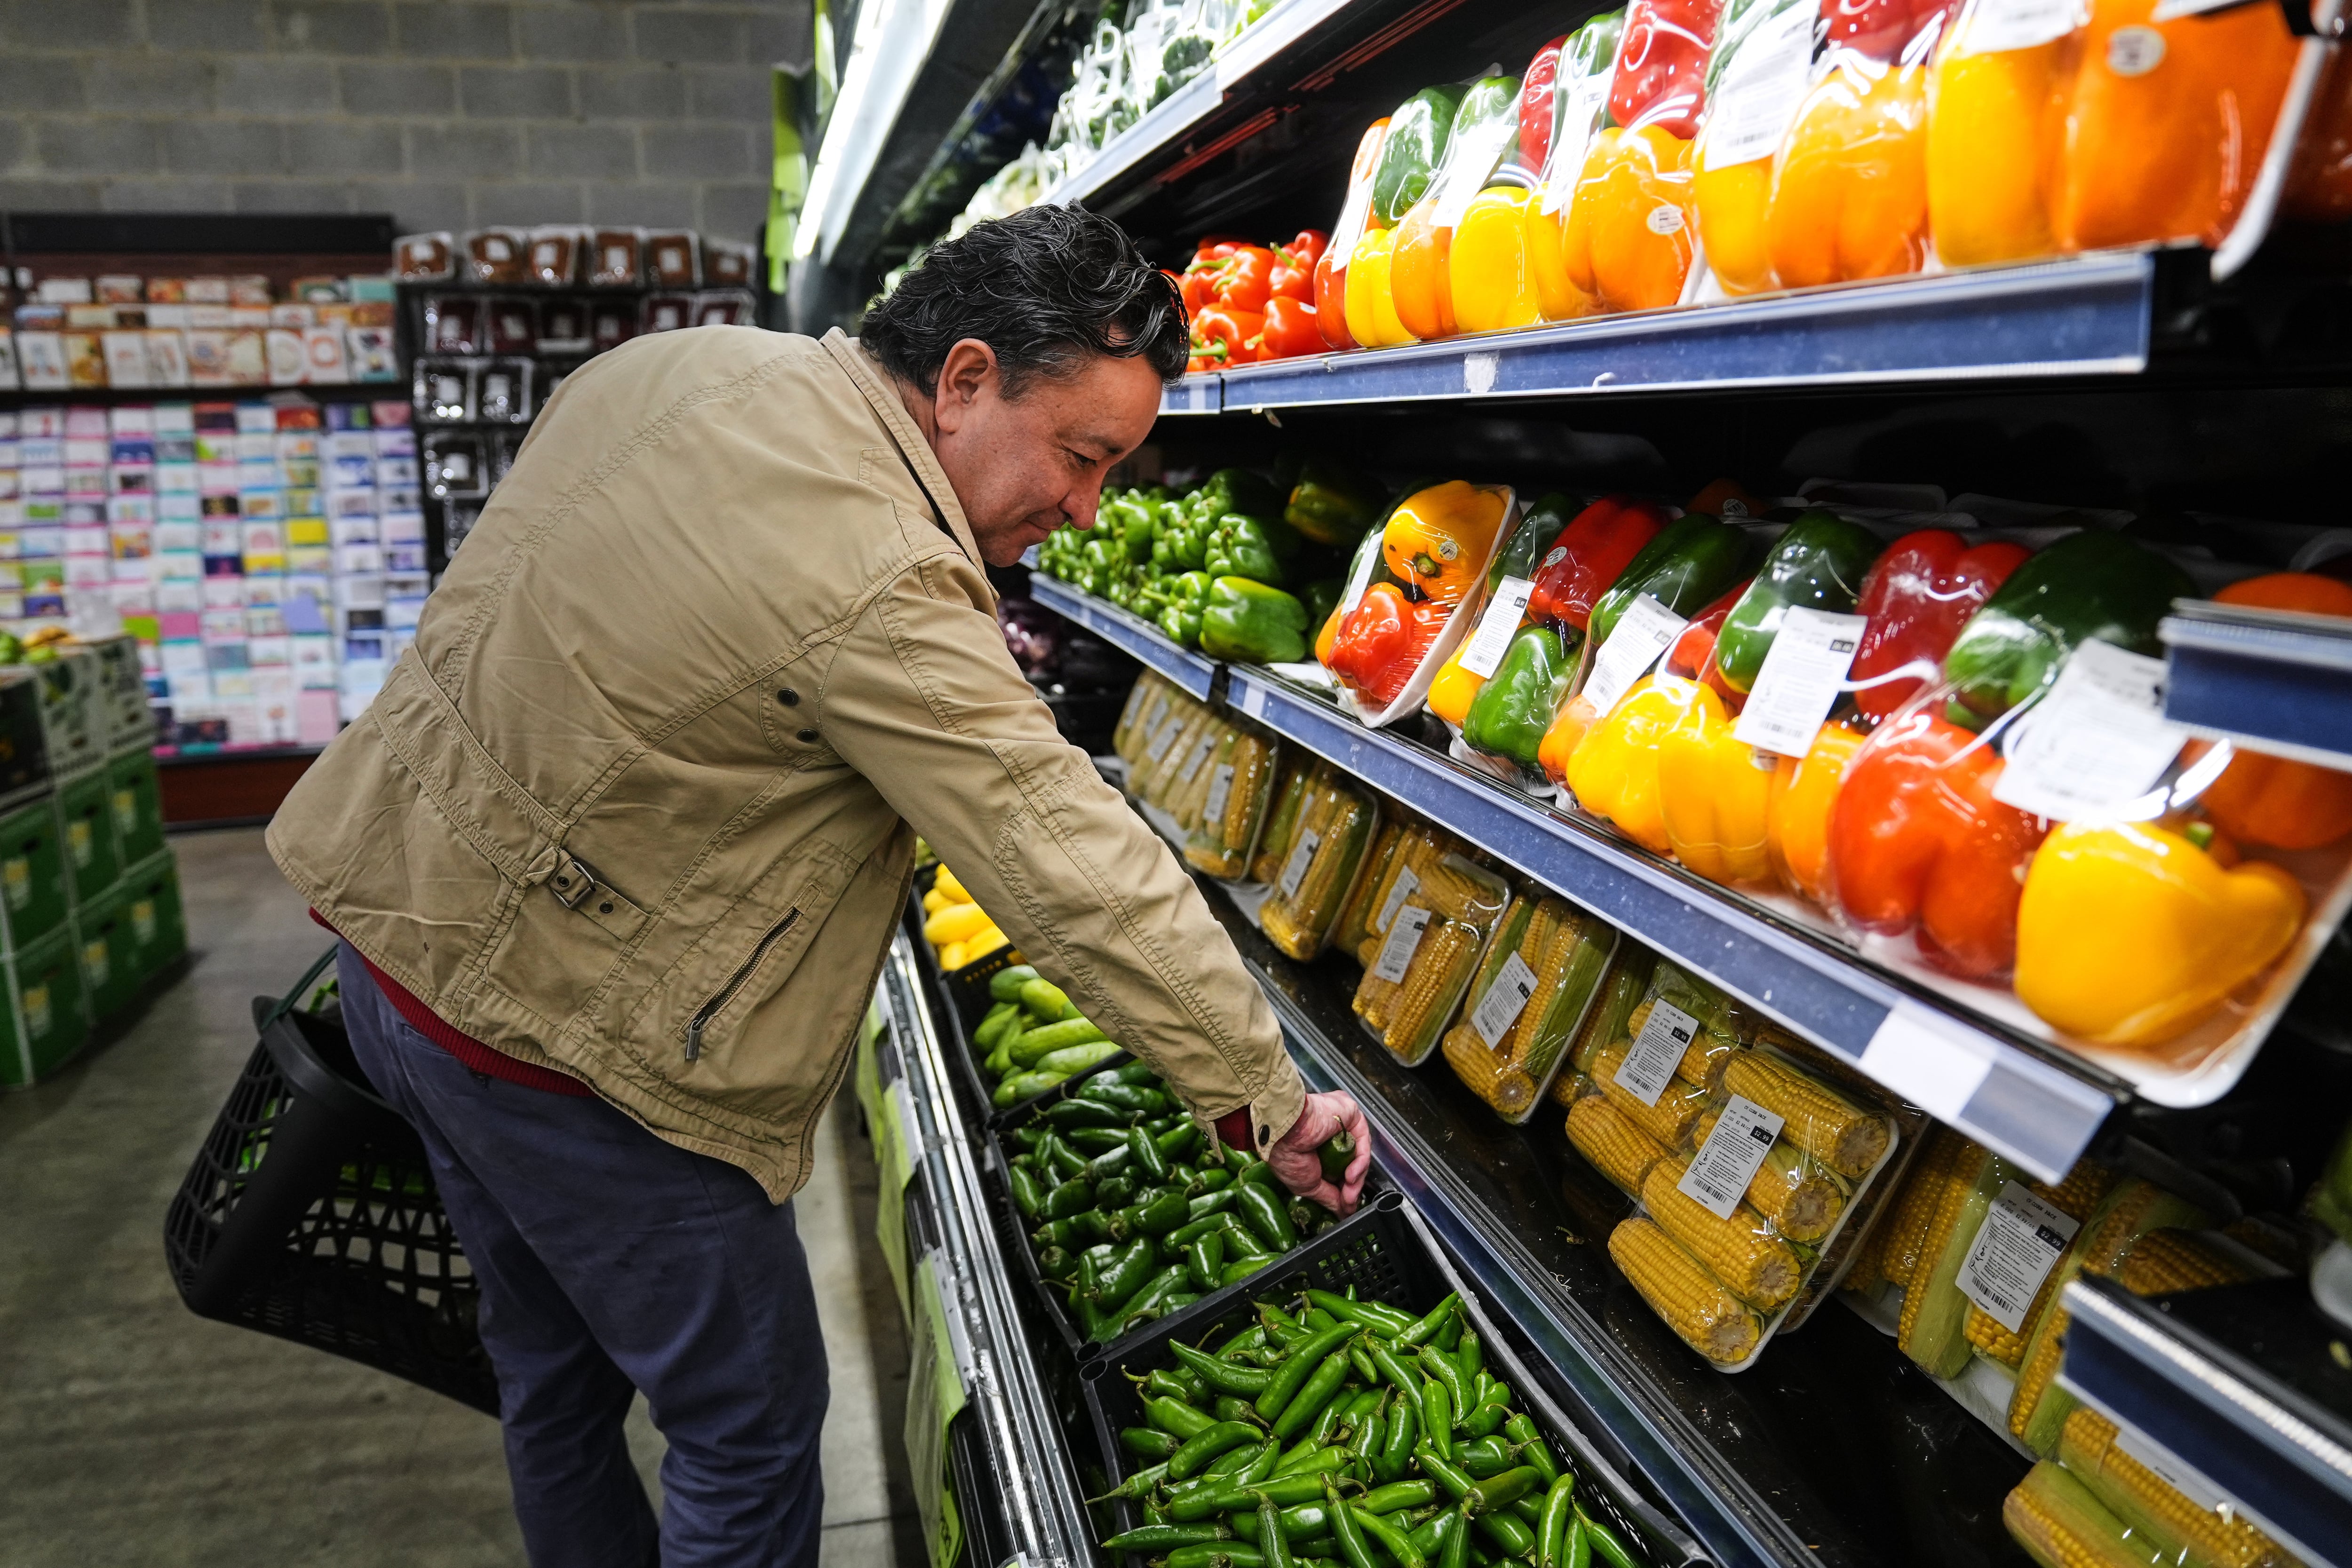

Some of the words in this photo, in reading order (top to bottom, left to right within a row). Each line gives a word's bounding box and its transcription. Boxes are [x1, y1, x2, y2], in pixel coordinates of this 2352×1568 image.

[1674, 1030, 1686, 1040] $2.99
[1754, 1131, 1769, 1141] $2.99
[2045, 1211, 2057, 1220] PACK
[2040, 1230, 2061, 1247] $2.99
